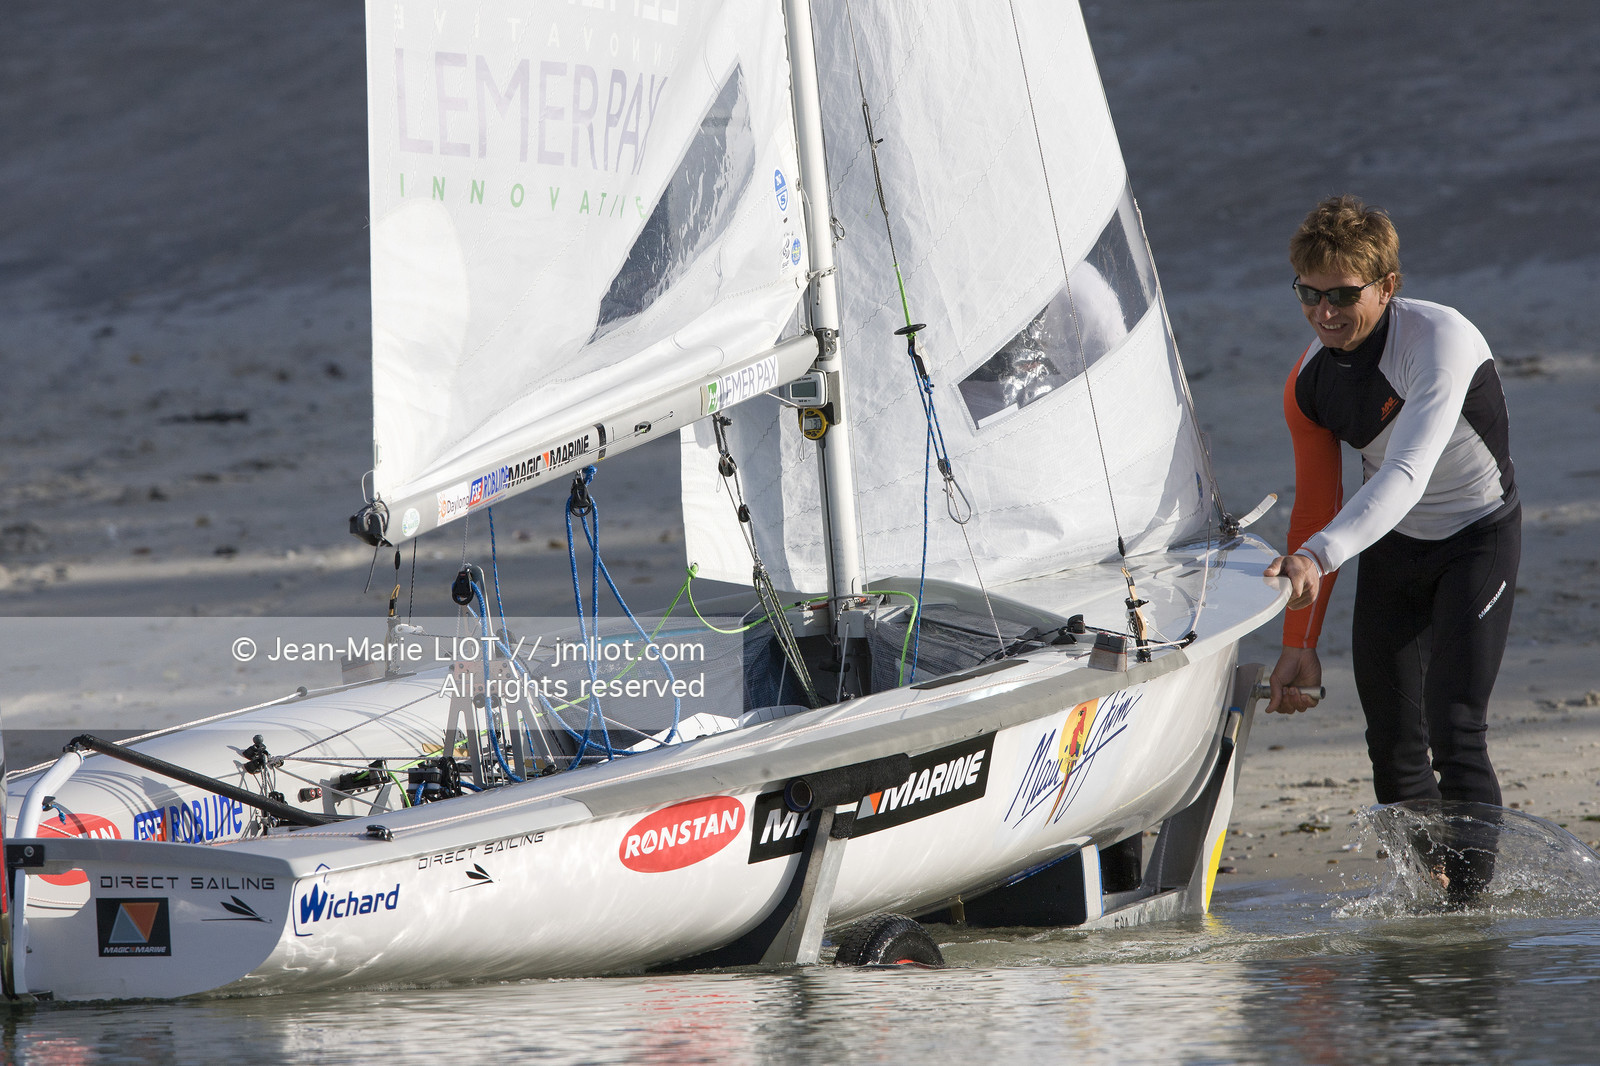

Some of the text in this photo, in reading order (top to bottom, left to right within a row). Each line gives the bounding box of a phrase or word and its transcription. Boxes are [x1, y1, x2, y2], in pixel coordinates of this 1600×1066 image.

[507, 434, 590, 489] MAGIC MARINE
[877, 749, 986, 815] MARINE
[418, 831, 545, 870] DIRECT SAILING
[624, 807, 740, 860] RONSTAN
[100, 876, 275, 890] DIRECT SAILING
[300, 883, 400, 924] Wichard
[103, 946, 130, 954] MAGIC
